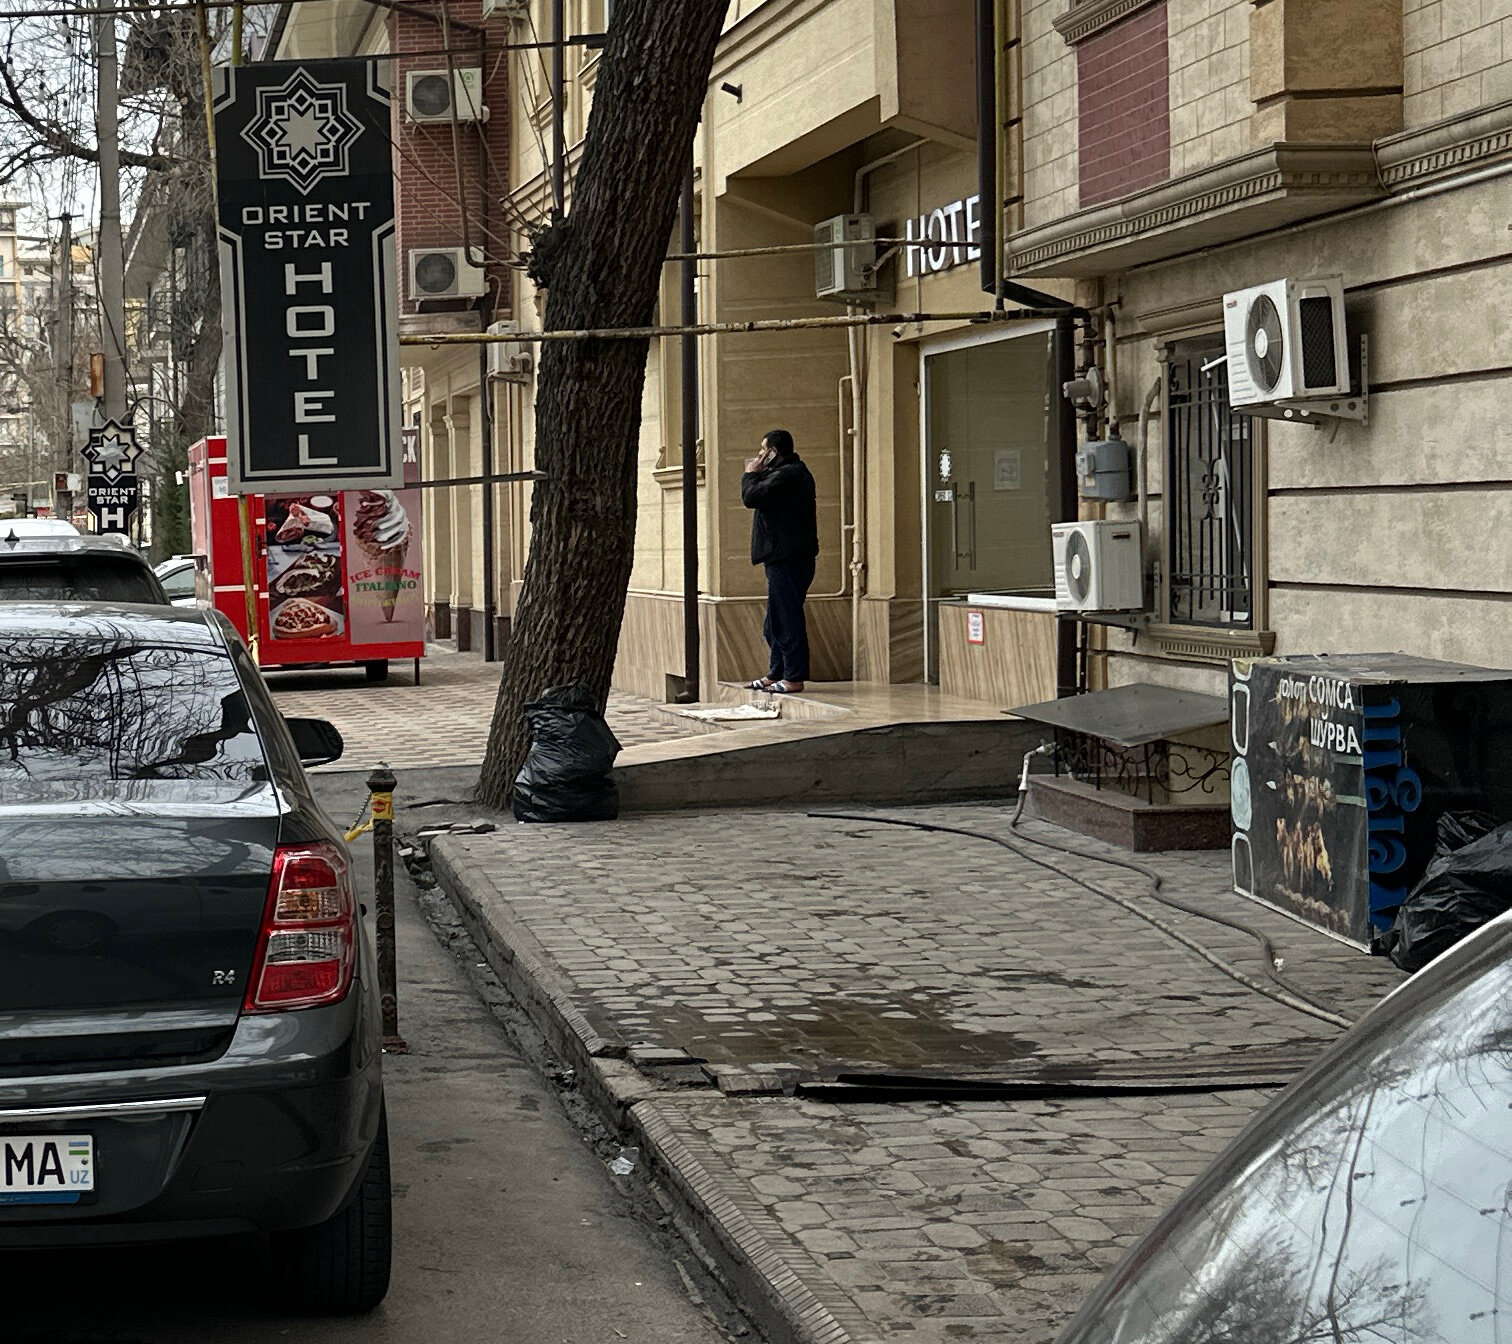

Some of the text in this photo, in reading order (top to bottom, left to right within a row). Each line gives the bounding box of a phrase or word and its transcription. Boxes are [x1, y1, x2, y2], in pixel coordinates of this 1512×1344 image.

[241, 202, 371, 225] ORIENT
[264, 228, 350, 250] STAR
[284, 261, 338, 466] HOTEL
[88, 487, 136, 496] ORIENT
[96, 496, 129, 505] STAR
[349, 569, 373, 584] ICE
[1309, 675, 1355, 711] СОМСА
[212, 969, 235, 985] R4
[70, 1169, 90, 1184] UZ
